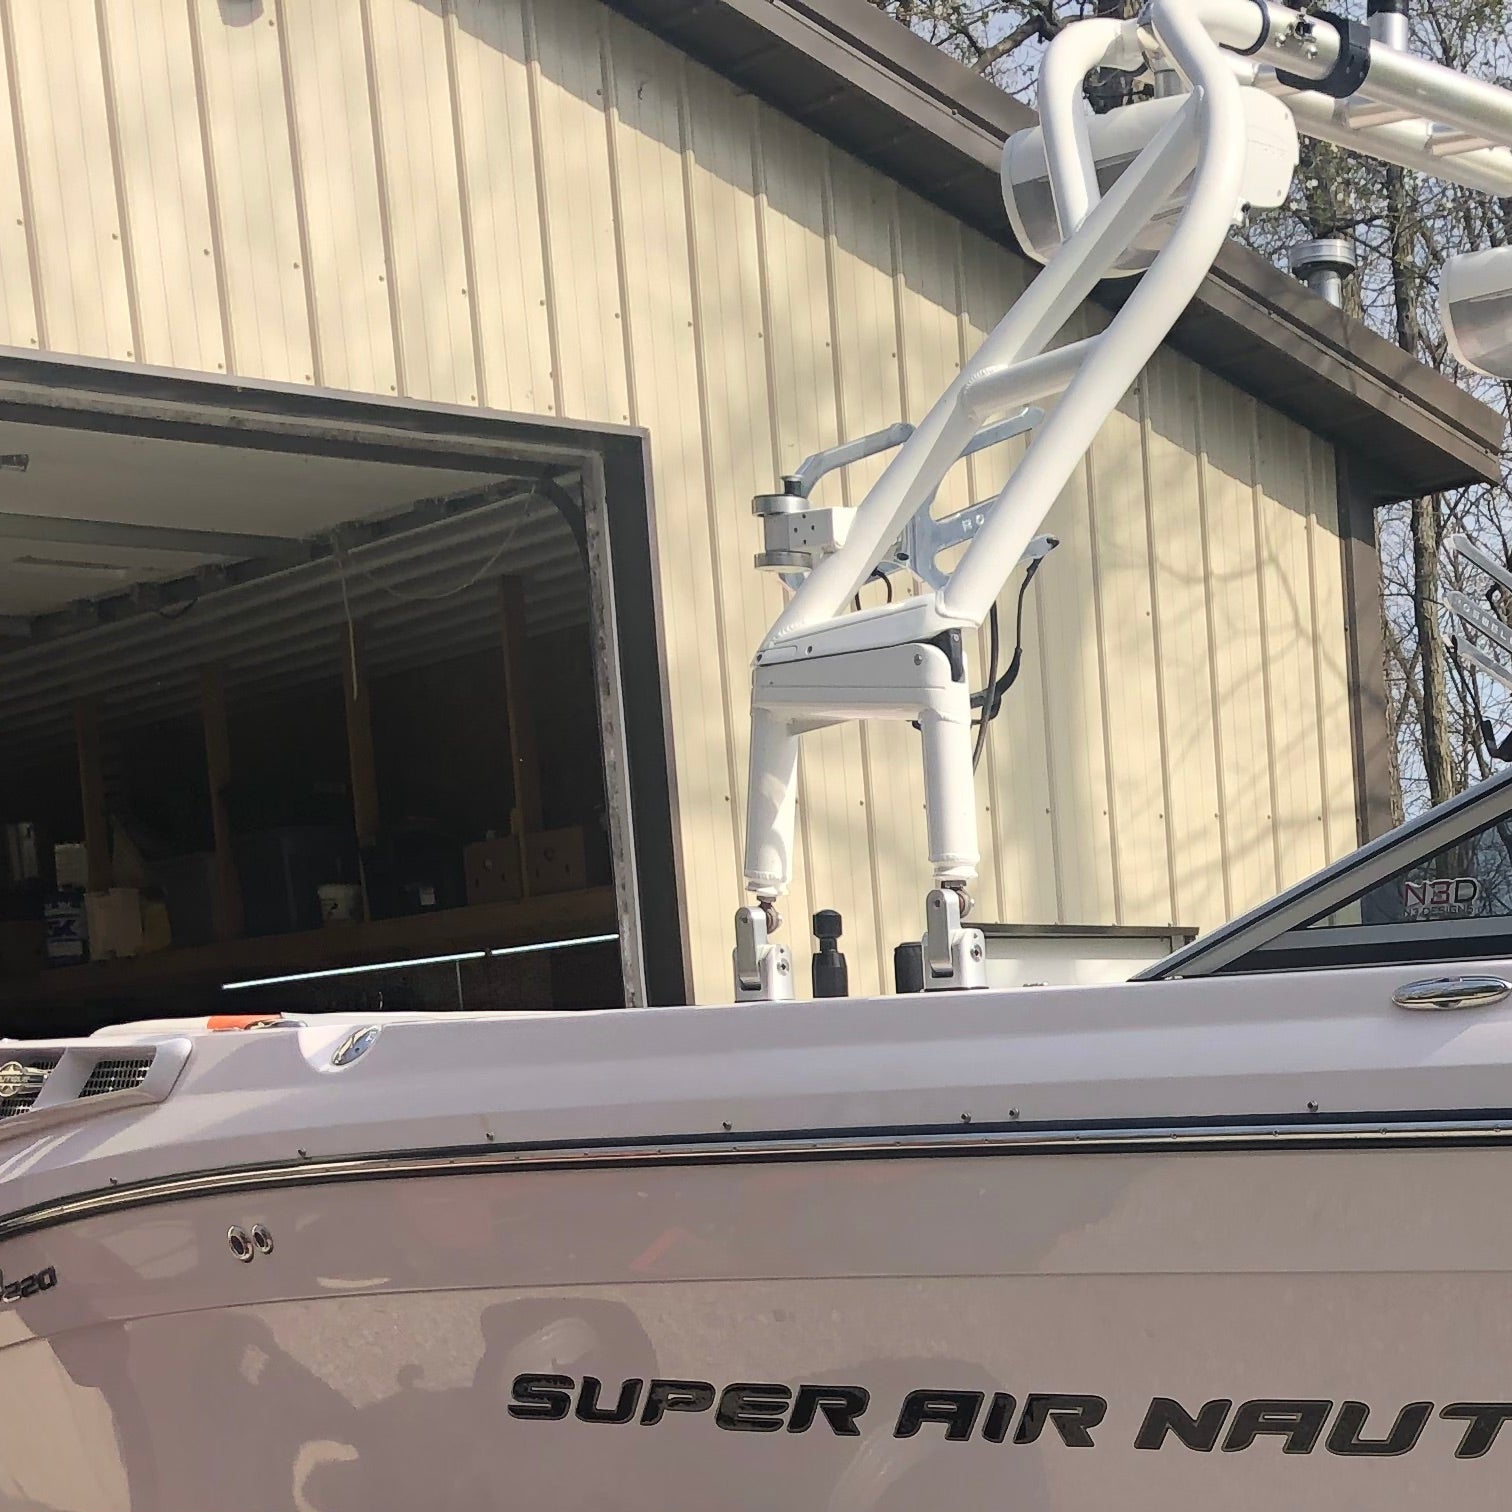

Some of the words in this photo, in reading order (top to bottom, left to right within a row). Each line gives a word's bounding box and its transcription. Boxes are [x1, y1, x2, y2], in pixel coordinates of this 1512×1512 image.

[1405, 880, 1477, 906] N3D
[508, 1373, 870, 1436] SUPER
[893, 1389, 1108, 1447] AIR
